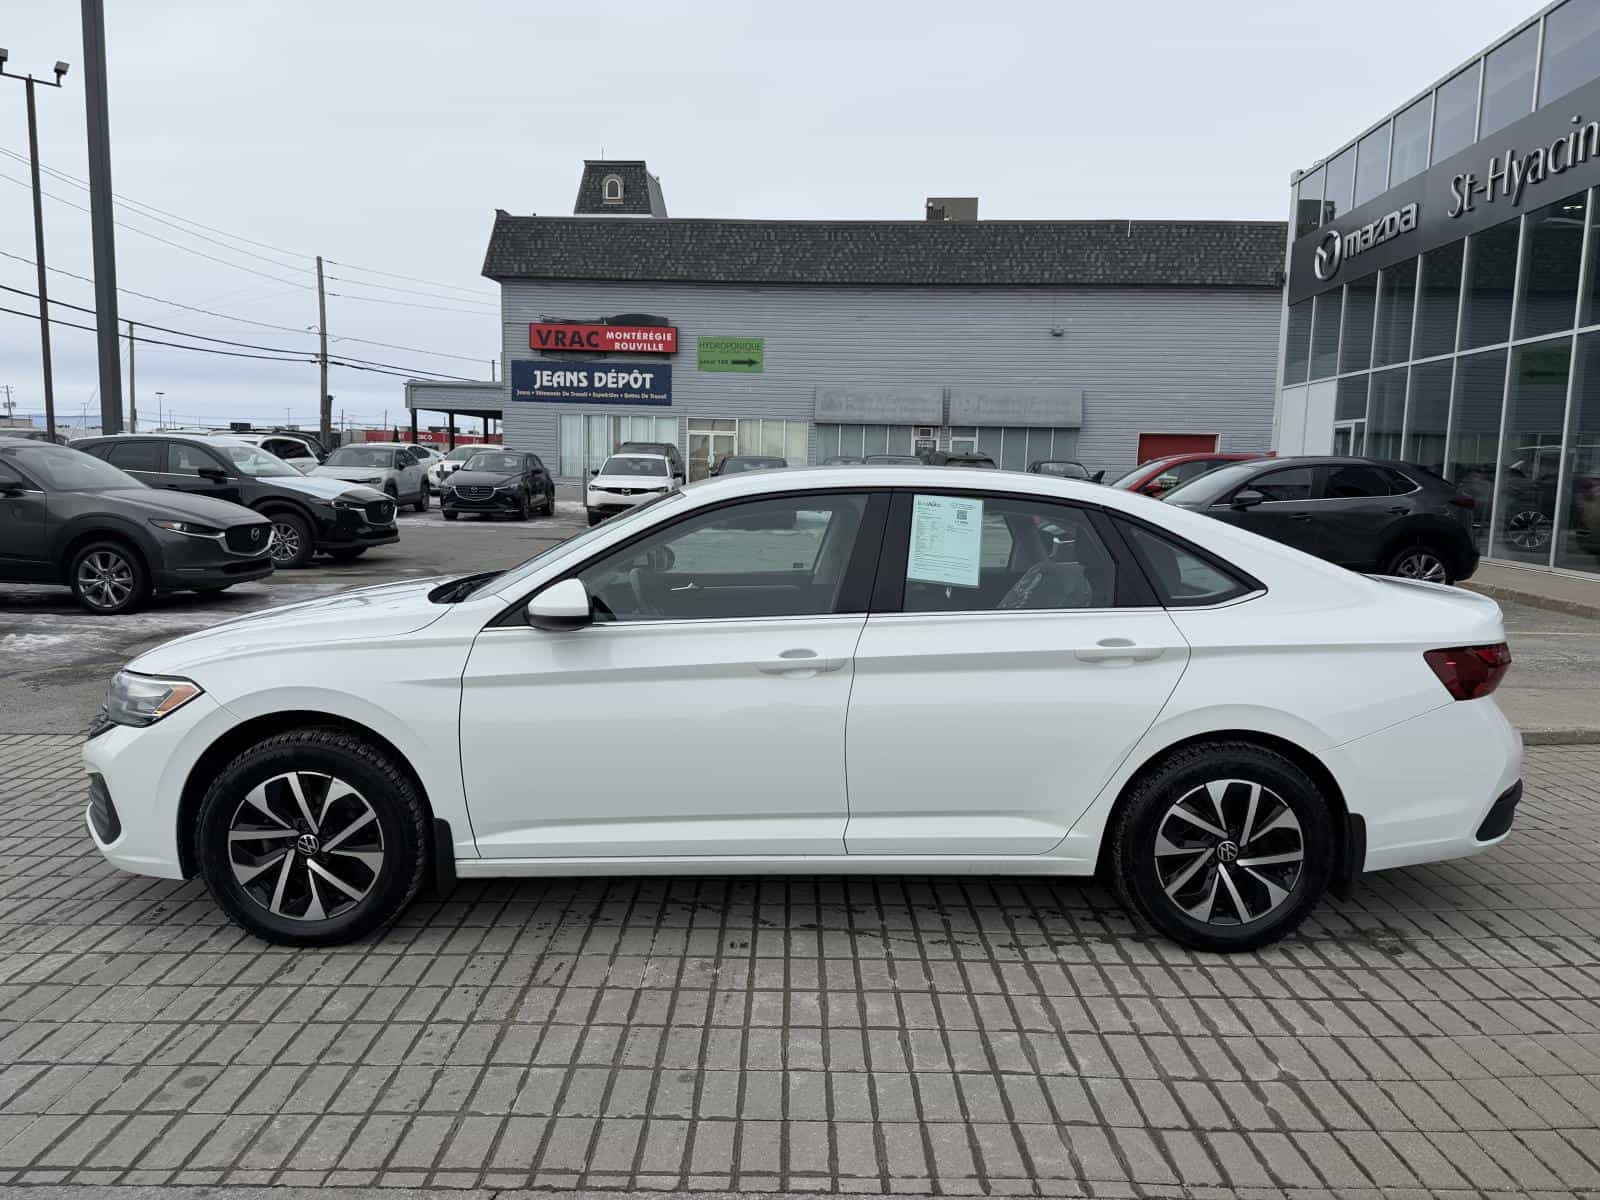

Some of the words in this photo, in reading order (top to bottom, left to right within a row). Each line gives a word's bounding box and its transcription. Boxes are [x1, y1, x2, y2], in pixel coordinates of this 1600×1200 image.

[1342, 202, 1419, 260] mazda
[536, 329, 599, 347] VRAC
[606, 330, 672, 341] MONTÉRÉGIE
[614, 342, 664, 352] ROUVILLE
[534, 370, 589, 388] JEANS
[594, 368, 654, 389] DÉPÔT
